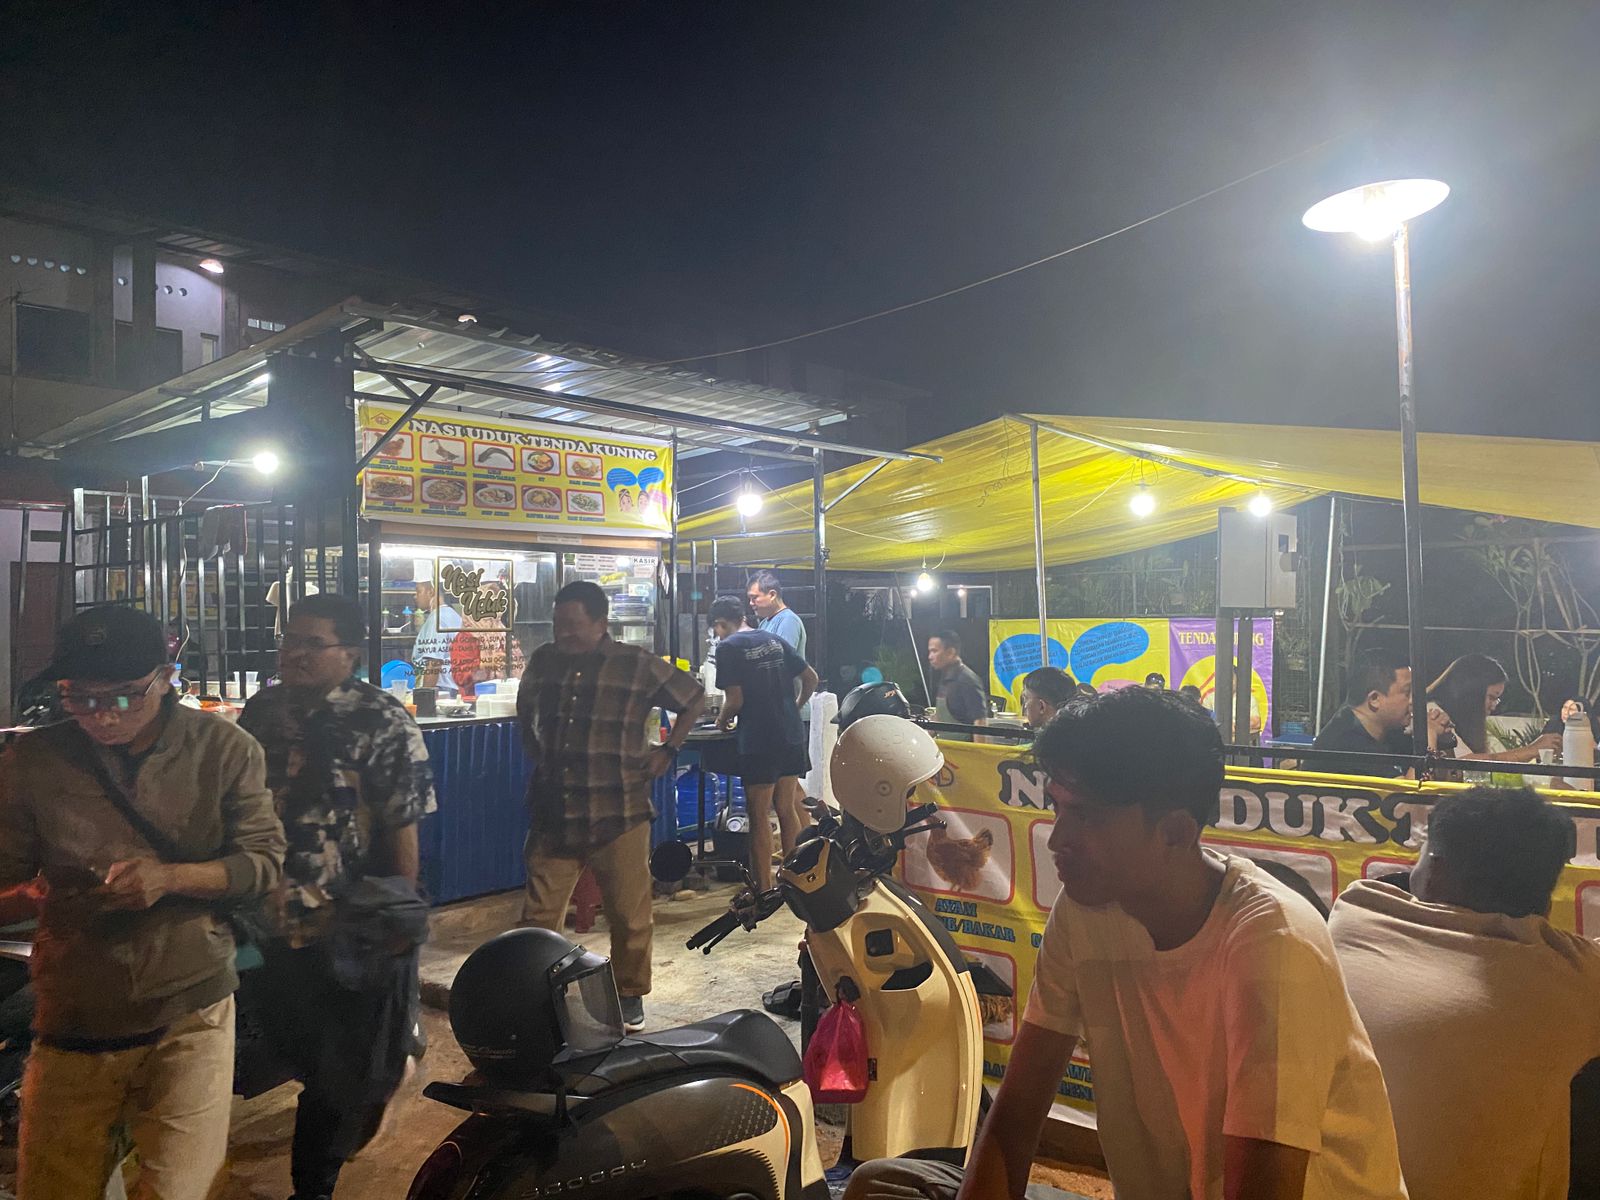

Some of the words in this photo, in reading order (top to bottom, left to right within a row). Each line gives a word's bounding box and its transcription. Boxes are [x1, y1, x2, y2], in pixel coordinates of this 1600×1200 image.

[411, 419, 463, 440] NASI
[466, 426, 526, 447] UDUK
[527, 434, 589, 454] TENDA
[591, 443, 657, 462] KUNING
[441, 563, 485, 597] Nasi
[460, 590, 507, 622] Uduk
[1179, 631, 1216, 645] TENDA
[1214, 787, 1377, 844] DUK
[935, 898, 977, 917] AYAM
